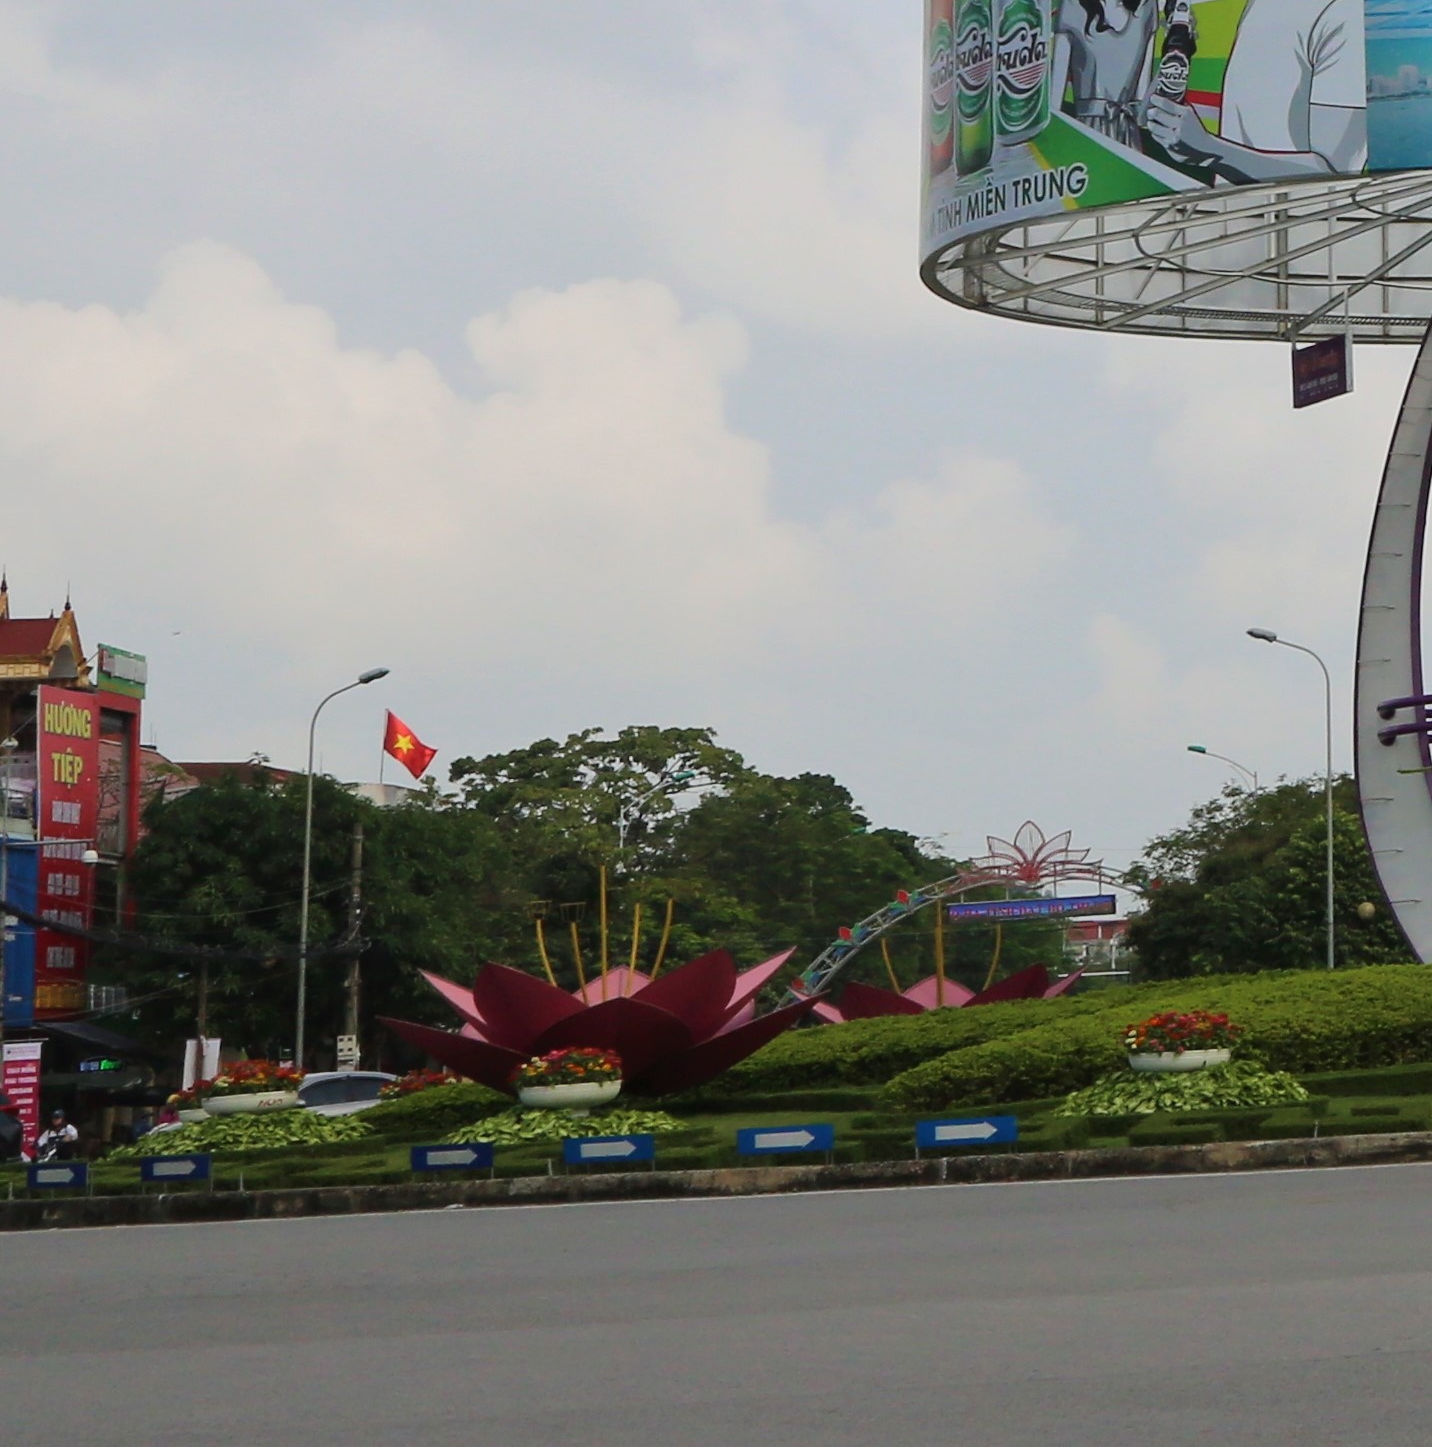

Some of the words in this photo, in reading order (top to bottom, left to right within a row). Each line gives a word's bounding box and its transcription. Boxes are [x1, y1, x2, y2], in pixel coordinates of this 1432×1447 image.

[966, 177, 1006, 223] MIỀN
[1012, 165, 1087, 209] TRUNG
[44, 701, 92, 740] HƯƠNG
[51, 747, 84, 789] TIỆP
